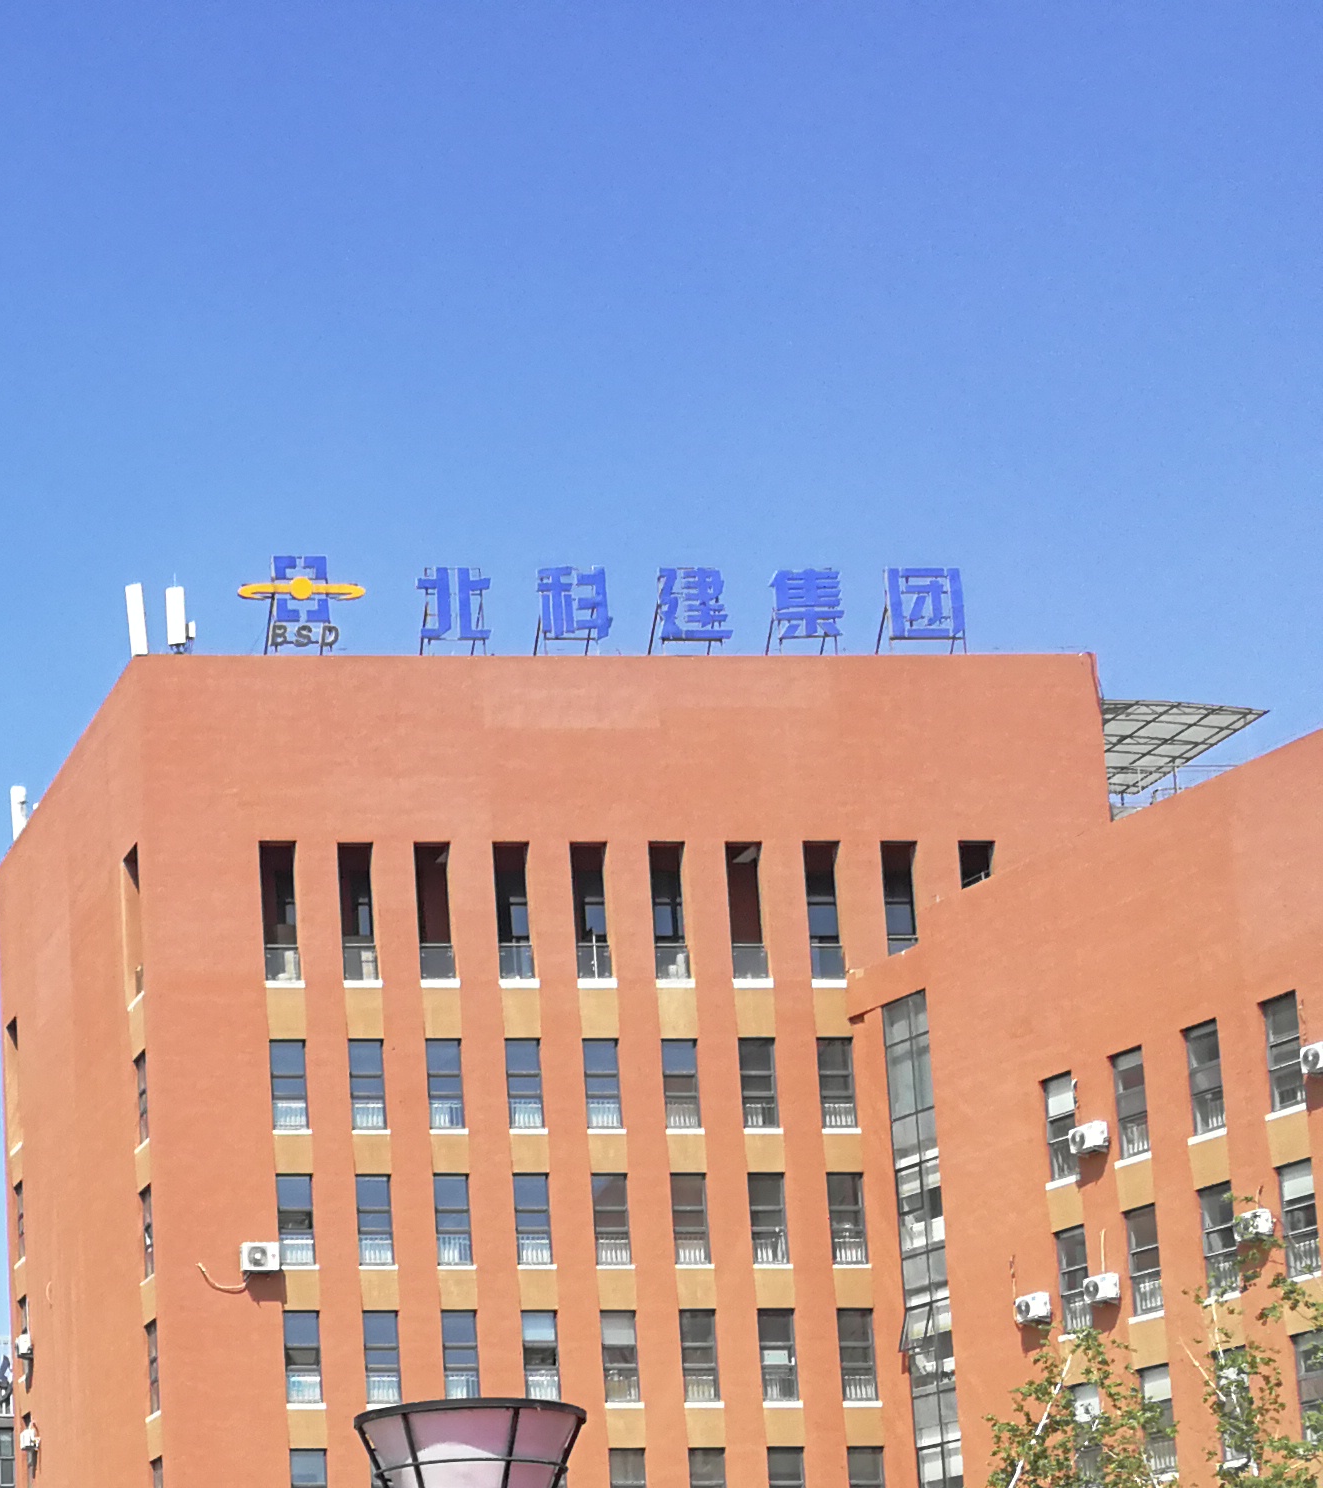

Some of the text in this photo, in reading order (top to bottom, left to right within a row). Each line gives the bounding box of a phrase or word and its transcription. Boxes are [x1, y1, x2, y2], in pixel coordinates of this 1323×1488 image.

[415, 566, 963, 643] 北科建集团
[269, 620, 341, 649] BSD
